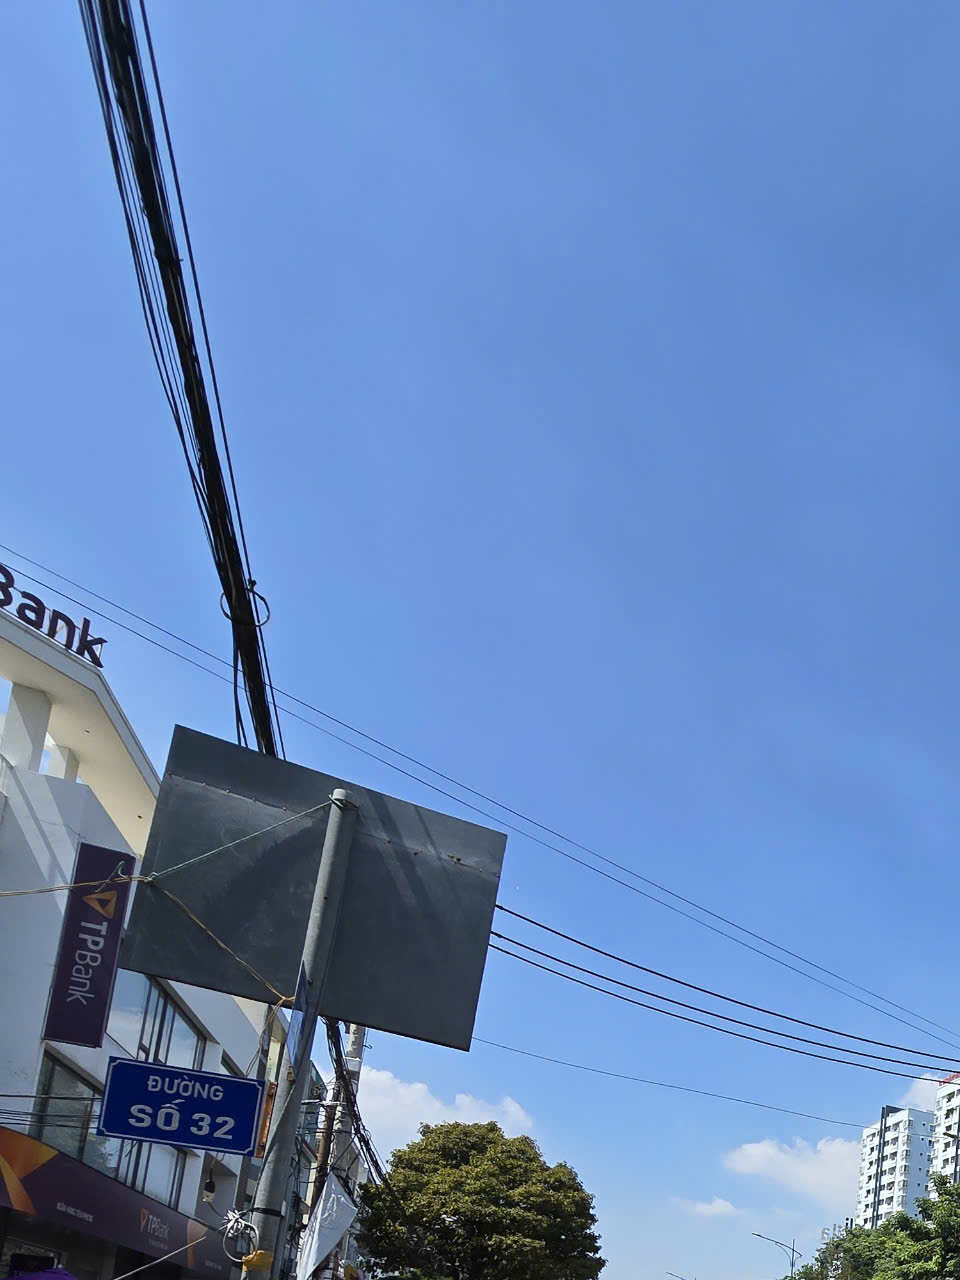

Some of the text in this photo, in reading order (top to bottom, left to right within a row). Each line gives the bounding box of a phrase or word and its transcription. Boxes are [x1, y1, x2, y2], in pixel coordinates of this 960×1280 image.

[66, 921, 108, 1006] TPBank
[147, 1075, 224, 1101] ĐƯỜNG
[128, 1099, 235, 1140] SỐ 32
